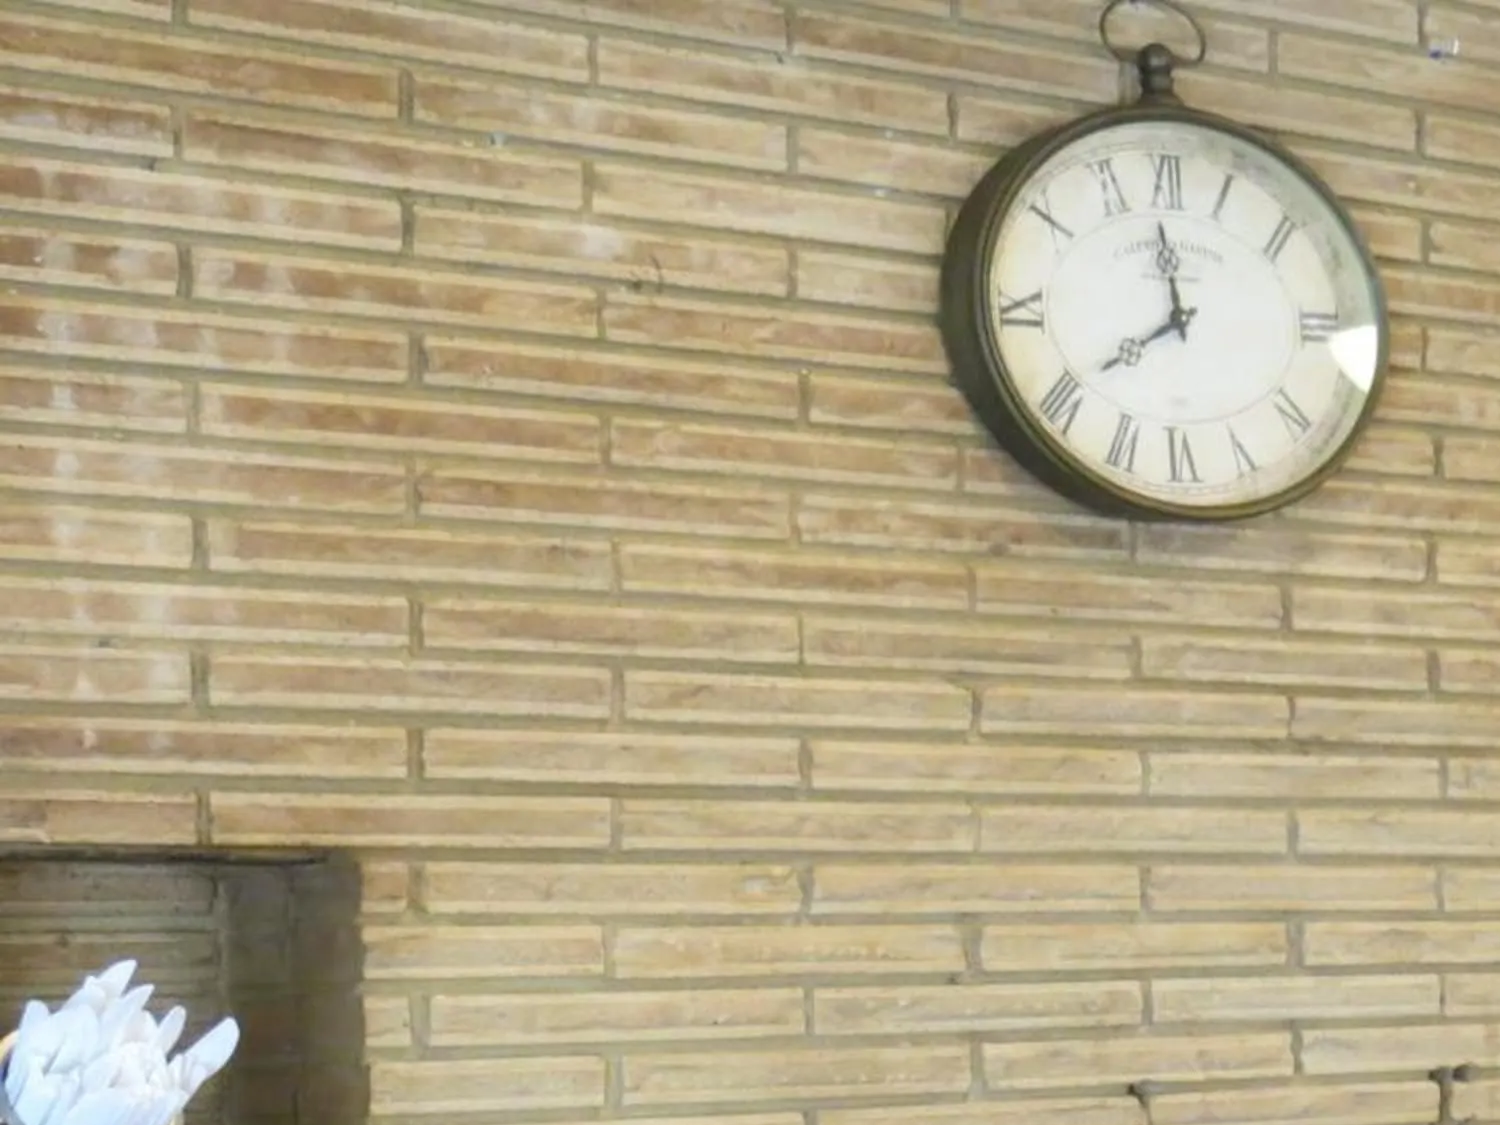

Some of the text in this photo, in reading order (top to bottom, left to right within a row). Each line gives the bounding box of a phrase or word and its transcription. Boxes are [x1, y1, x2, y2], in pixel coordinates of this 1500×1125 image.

[1086, 158, 1131, 217] XI
[1145, 153, 1184, 211] XII
[1208, 173, 1235, 224] I
[1029, 185, 1075, 255] X
[1262, 212, 1301, 267] II
[998, 286, 1045, 334] IX
[1299, 307, 1339, 348] III
[1104, 412, 1141, 474] VII
[1162, 425, 1204, 483] VI
